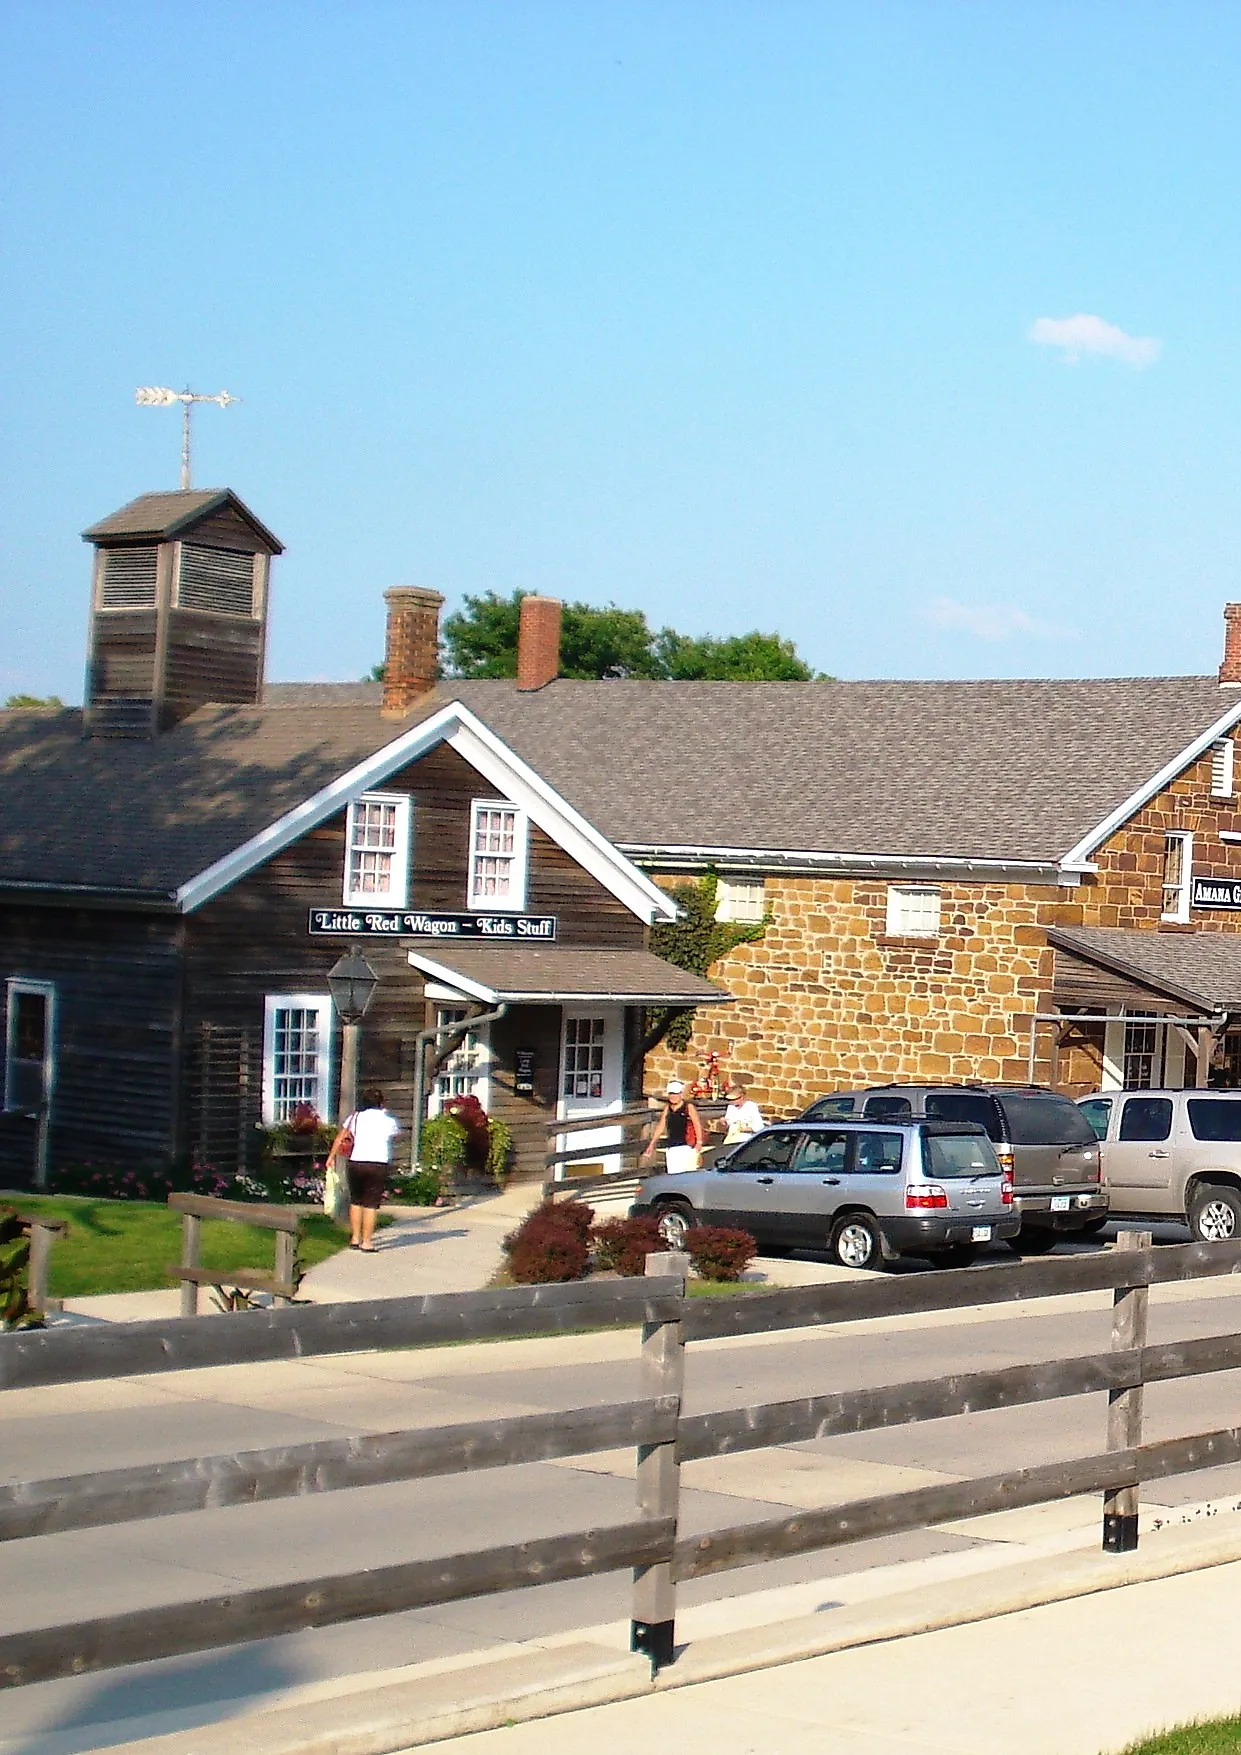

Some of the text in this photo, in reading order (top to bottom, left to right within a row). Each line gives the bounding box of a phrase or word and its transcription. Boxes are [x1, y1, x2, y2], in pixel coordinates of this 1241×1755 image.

[315, 912, 360, 931] Little
[365, 914, 399, 932] Red
[404, 915, 457, 935] Wagon
[476, 918, 512, 935] Kids
[517, 919, 551, 936] Stuff
